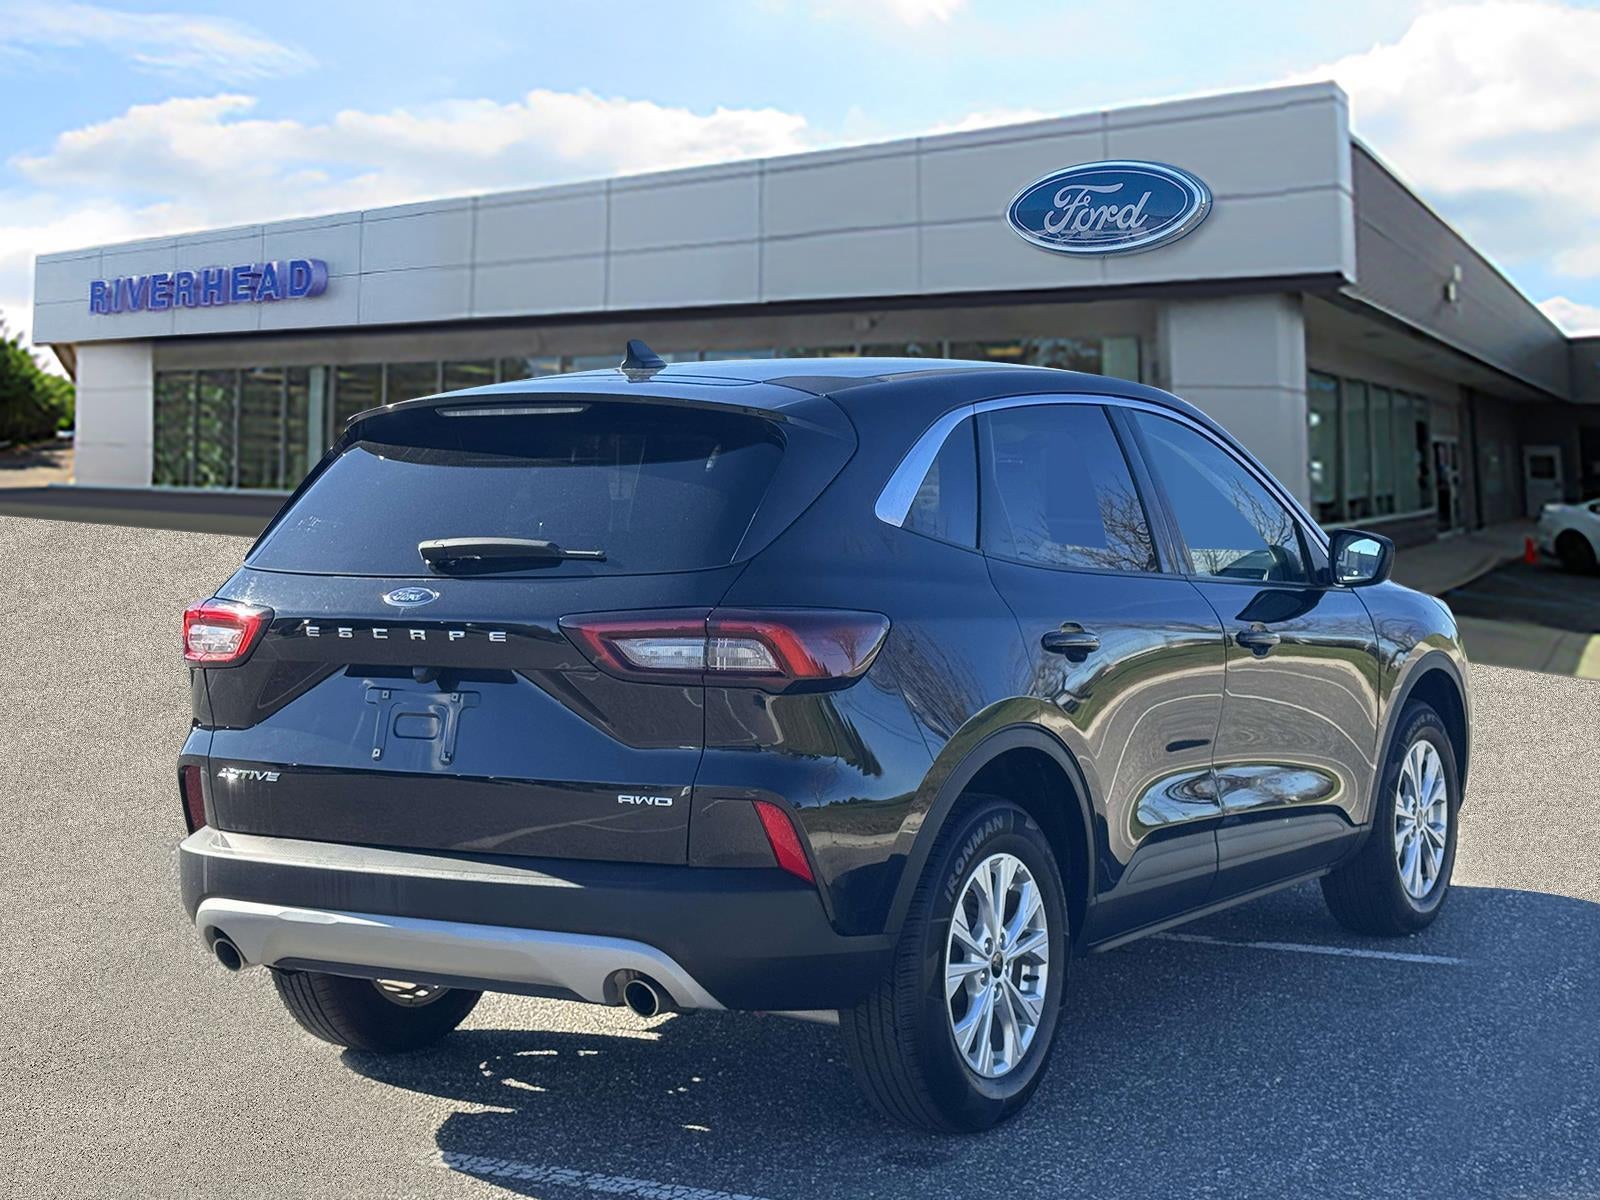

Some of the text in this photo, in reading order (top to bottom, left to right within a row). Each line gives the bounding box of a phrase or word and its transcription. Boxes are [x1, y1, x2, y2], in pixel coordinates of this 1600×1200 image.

[1043, 182, 1152, 234] Ford
[88, 257, 325, 315] RIVERHEAD
[305, 625, 508, 643] ESCAPE
[216, 767, 281, 782] ACTIVE
[617, 794, 673, 807] AWD
[943, 815, 1004, 902] IRONMAN
